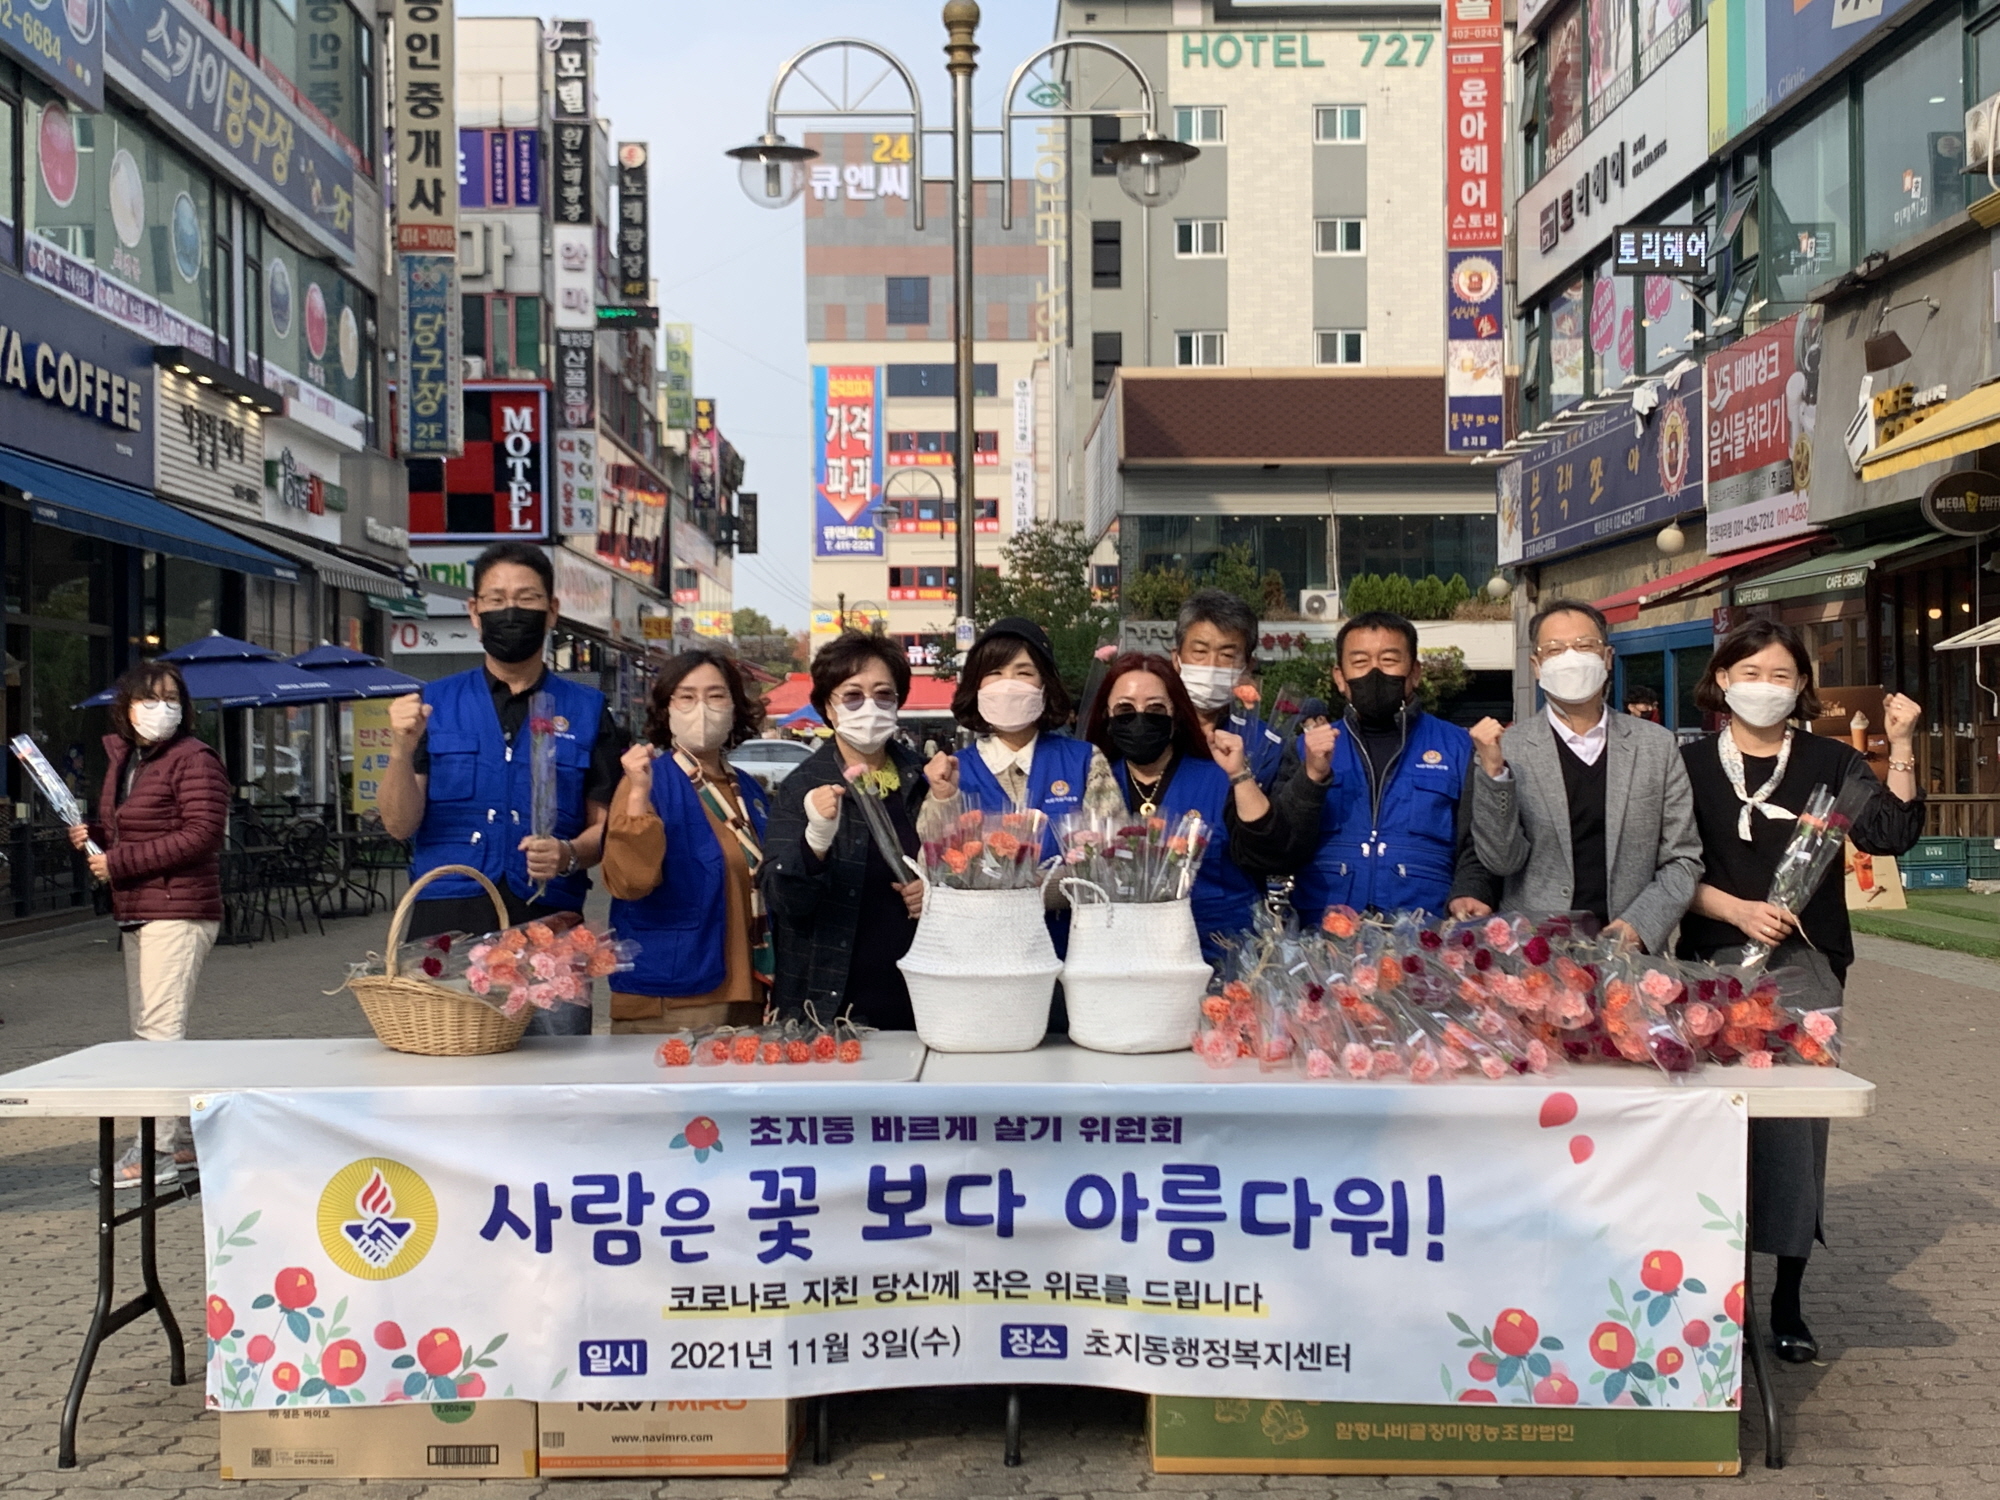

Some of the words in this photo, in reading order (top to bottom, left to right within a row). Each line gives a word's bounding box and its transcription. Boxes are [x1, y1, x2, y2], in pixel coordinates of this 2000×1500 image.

[0, 3, 62, 66] 2-6684
[1182, 35, 1324, 68] HOTEL
[1358, 34, 1434, 67] 727
[1778, 65, 1805, 98] Clinic
[871, 134, 912, 163] 24
[1459, 79, 1488, 208] 윤아헤어
[1452, 212, 1497, 228] 스토리
[1618, 231, 1706, 267] 토리헤어
[36, 342, 141, 432] COFFEE
[412, 313, 447, 417] 당구장
[1734, 341, 1780, 393] 비바싱크
[416, 423, 443, 439] 2F
[825, 404, 872, 451] 가격
[1709, 394, 1787, 468] 음식물처리기
[503, 406, 533, 531] MOTEL
[825, 455, 872, 502] 파괴
[1980, 496, 2000, 508] COFF
[1826, 575, 1842, 589] CAFE
[1843, 570, 1865, 588] CREMA
[750, 1115, 855, 1145] 초지동
[871, 1114, 977, 1143] 바르게
[993, 1115, 1062, 1143] 살기
[1079, 1114, 1183, 1145] 위원회
[479, 1171, 714, 1266] 사람은
[748, 1166, 820, 1265] 꽃
[861, 1164, 1027, 1241] 보다
[1065, 1163, 1445, 1263] 아름다워!
[668, 1282, 790, 1313] 코로나로
[802, 1275, 858, 1308] 지친
[873, 1273, 960, 1303] 당신께
[972, 1271, 1031, 1302] 작은
[1043, 1272, 1131, 1306] 위로를
[1143, 1281, 1263, 1313] 드립니다
[586, 1344, 638, 1373] 일시
[670, 1341, 773, 1369] 2021년
[788, 1332, 849, 1366] 11월
[862, 1326, 961, 1361] 3일(수)
[1008, 1328, 1061, 1356] 장소
[1083, 1329, 1351, 1373] 초지동행정복지센터
[611, 1432, 713, 1443] www.navimro.com
